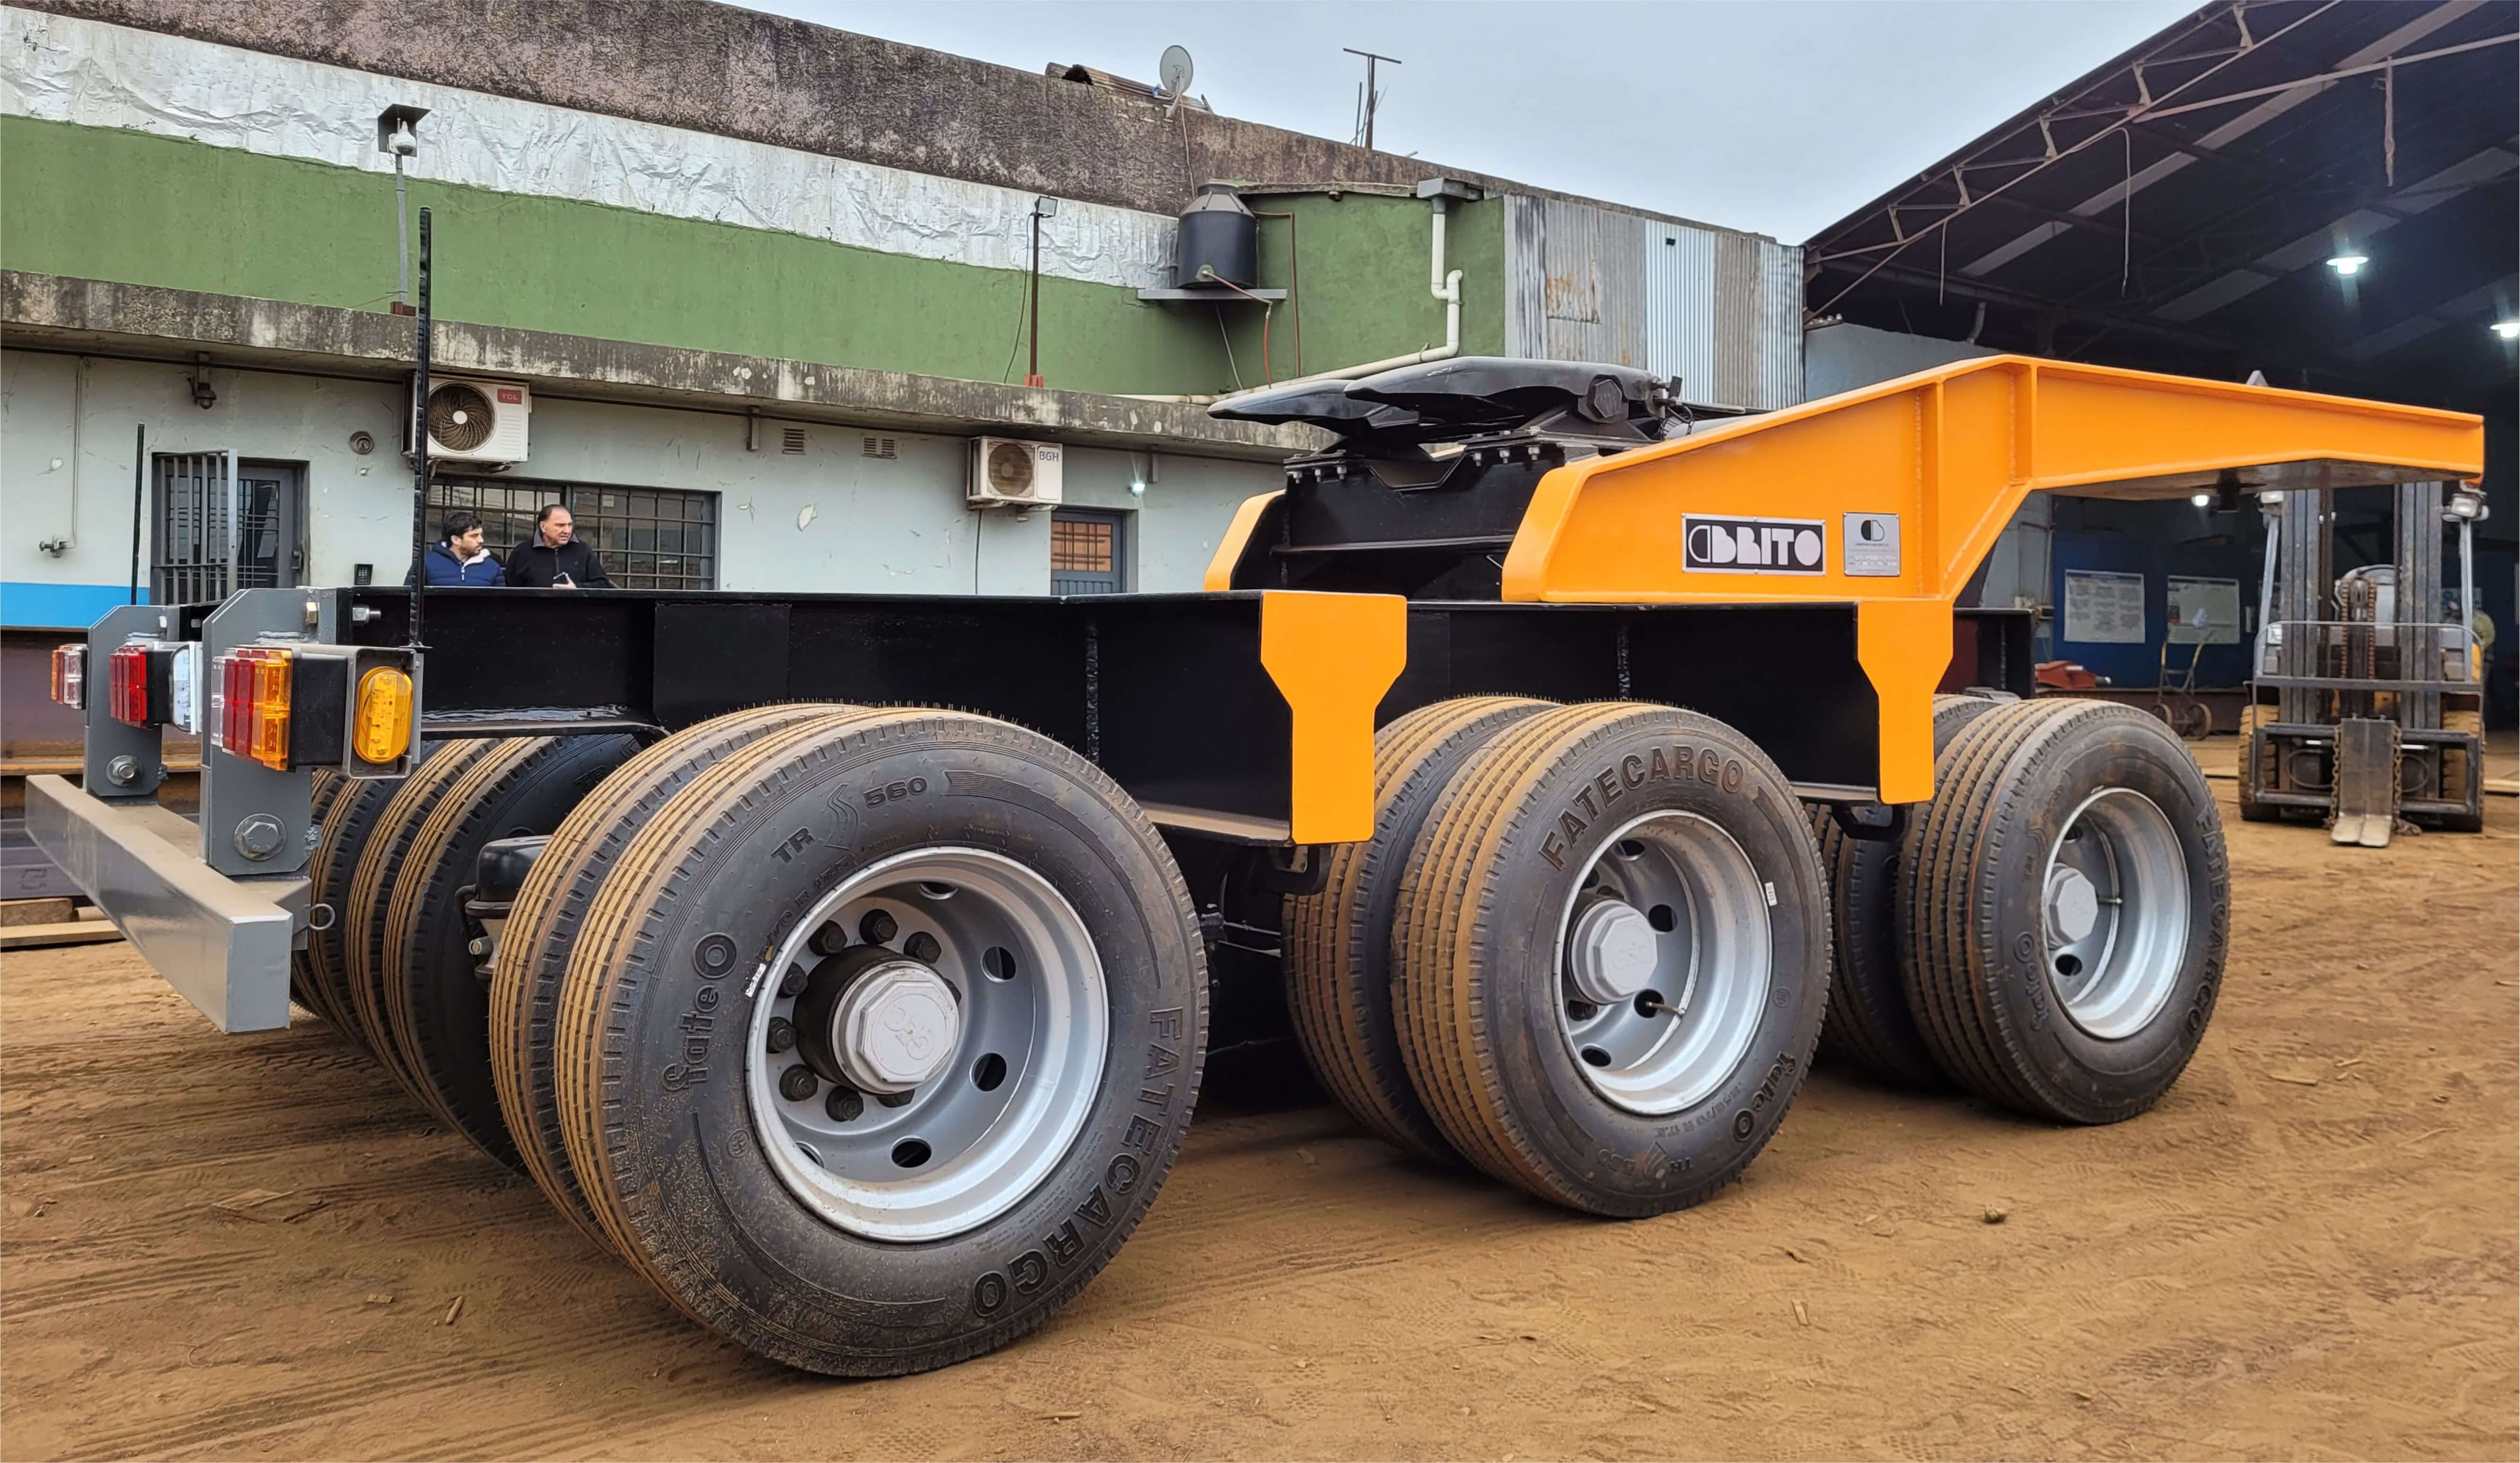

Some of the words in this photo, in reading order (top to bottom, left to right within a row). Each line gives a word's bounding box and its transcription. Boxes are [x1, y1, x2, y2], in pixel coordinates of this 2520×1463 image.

[1039, 451, 1059, 462] BGH
[770, 827, 816, 864] TR
[862, 777, 928, 809] 560
[1538, 744, 1745, 872] FATECARGO
[2185, 804, 2226, 1037] FATECARGO
[973, 1006, 1184, 1318] FATECARGO
